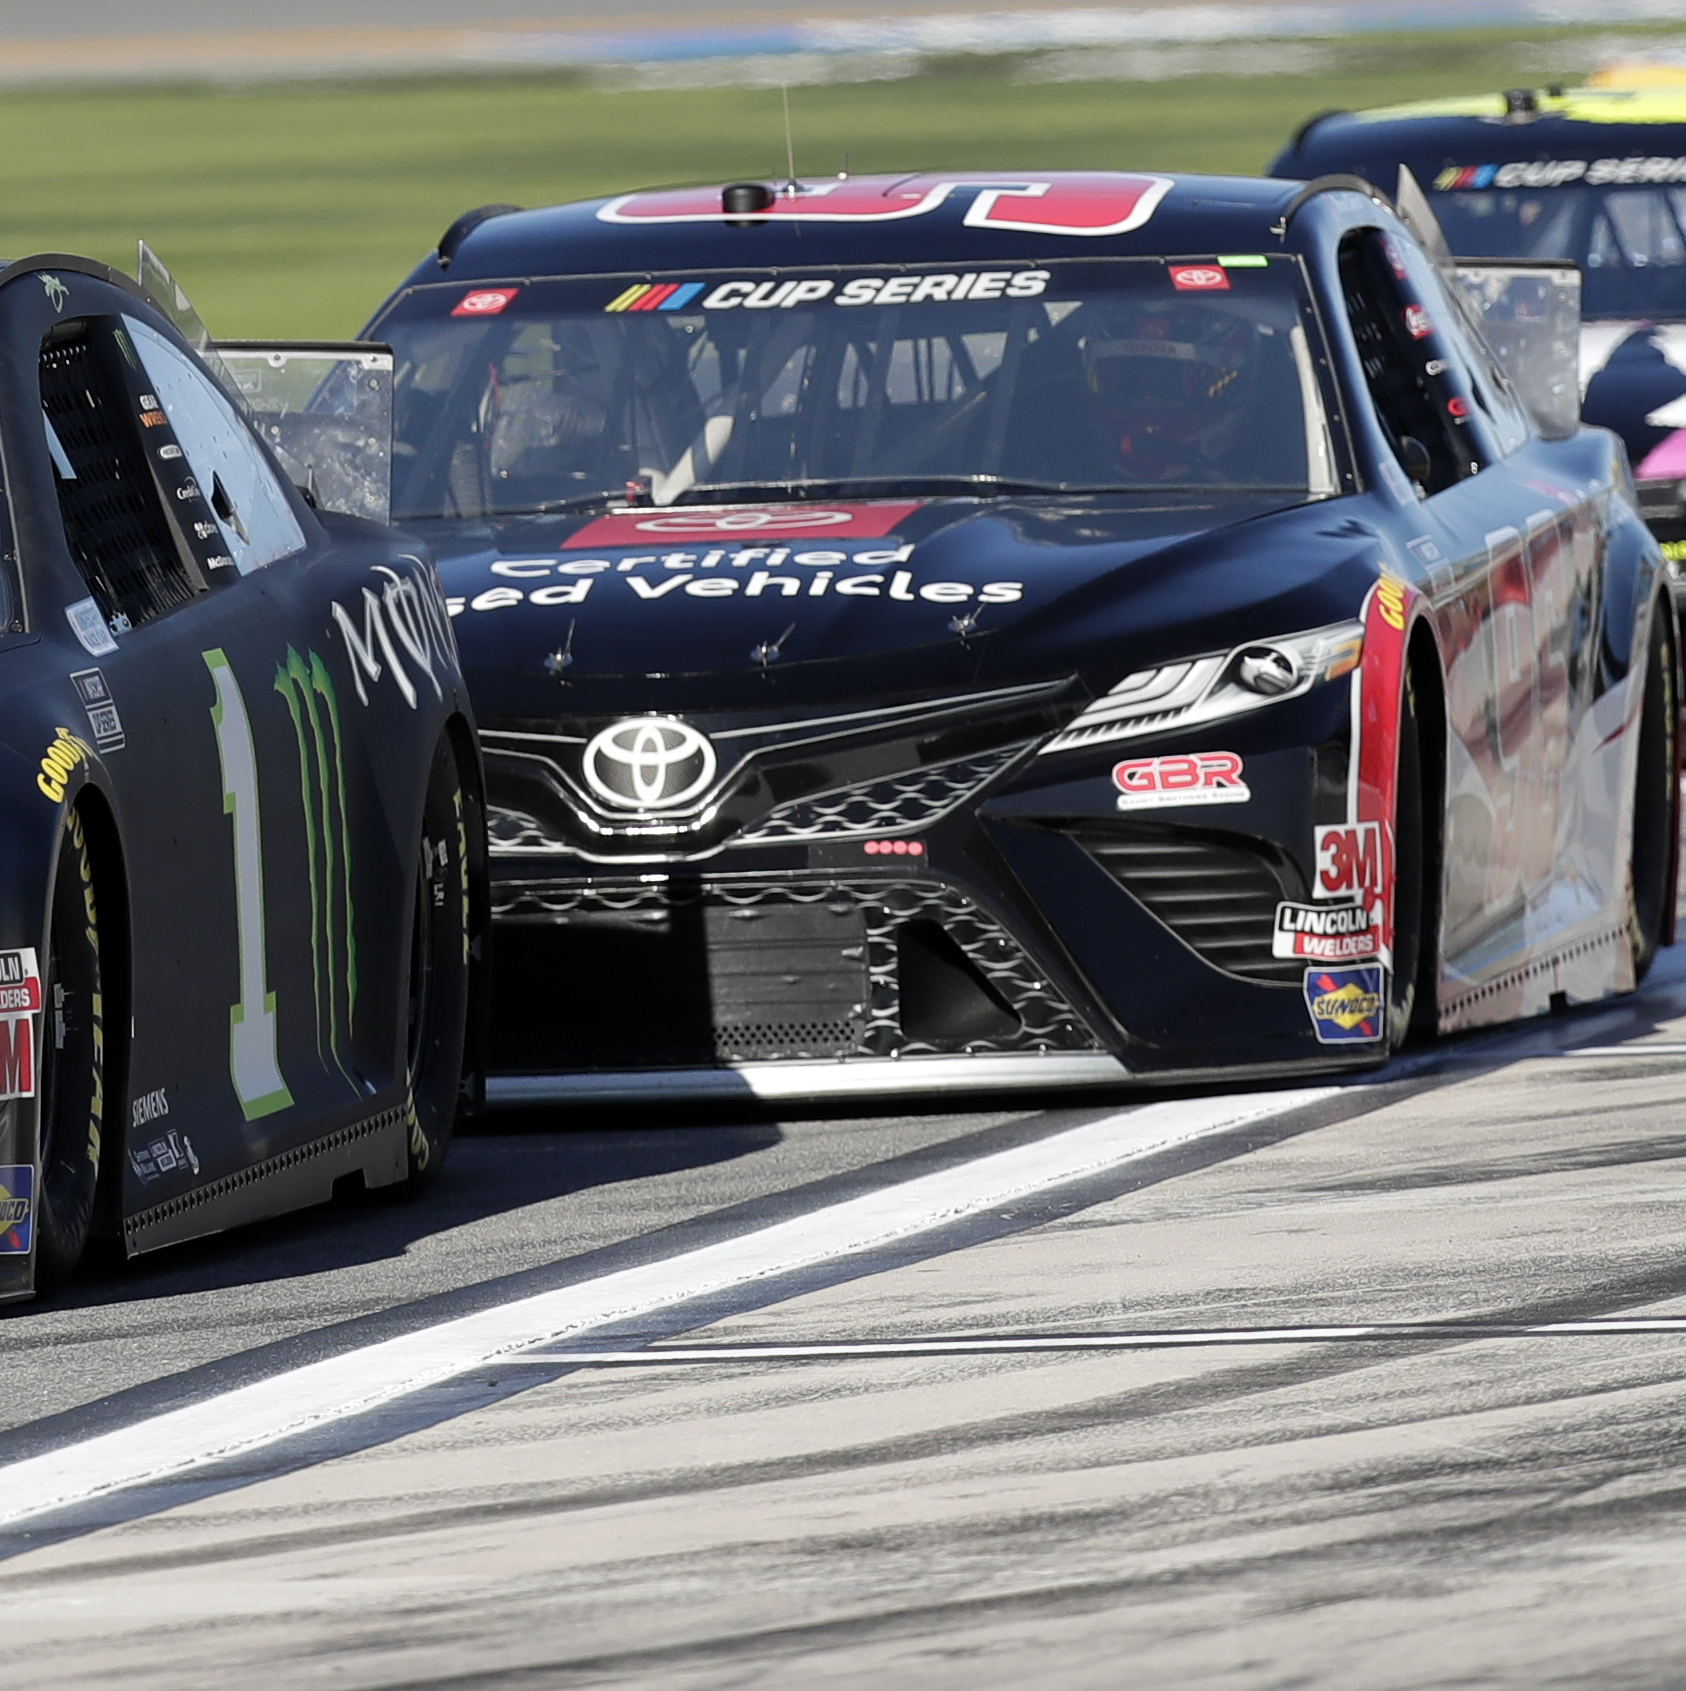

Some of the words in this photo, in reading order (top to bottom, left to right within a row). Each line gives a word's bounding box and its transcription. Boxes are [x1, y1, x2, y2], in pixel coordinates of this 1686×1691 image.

[1494, 161, 1588, 188] CUP
[702, 280, 834, 309] CUP
[833, 270, 1051, 306] SERIES
[489, 543, 915, 579] Certified
[624, 571, 1025, 603] Vehicles
[1114, 753, 1242, 792] GBR
[1320, 827, 1377, 892] 3M
[201, 647, 295, 1122] 1
[1282, 908, 1368, 932] LINCOLN
[1302, 934, 1374, 956] WELDERS
[1316, 994, 1377, 1016] SUNOCO
[132, 1087, 169, 1128] SIEMENS
